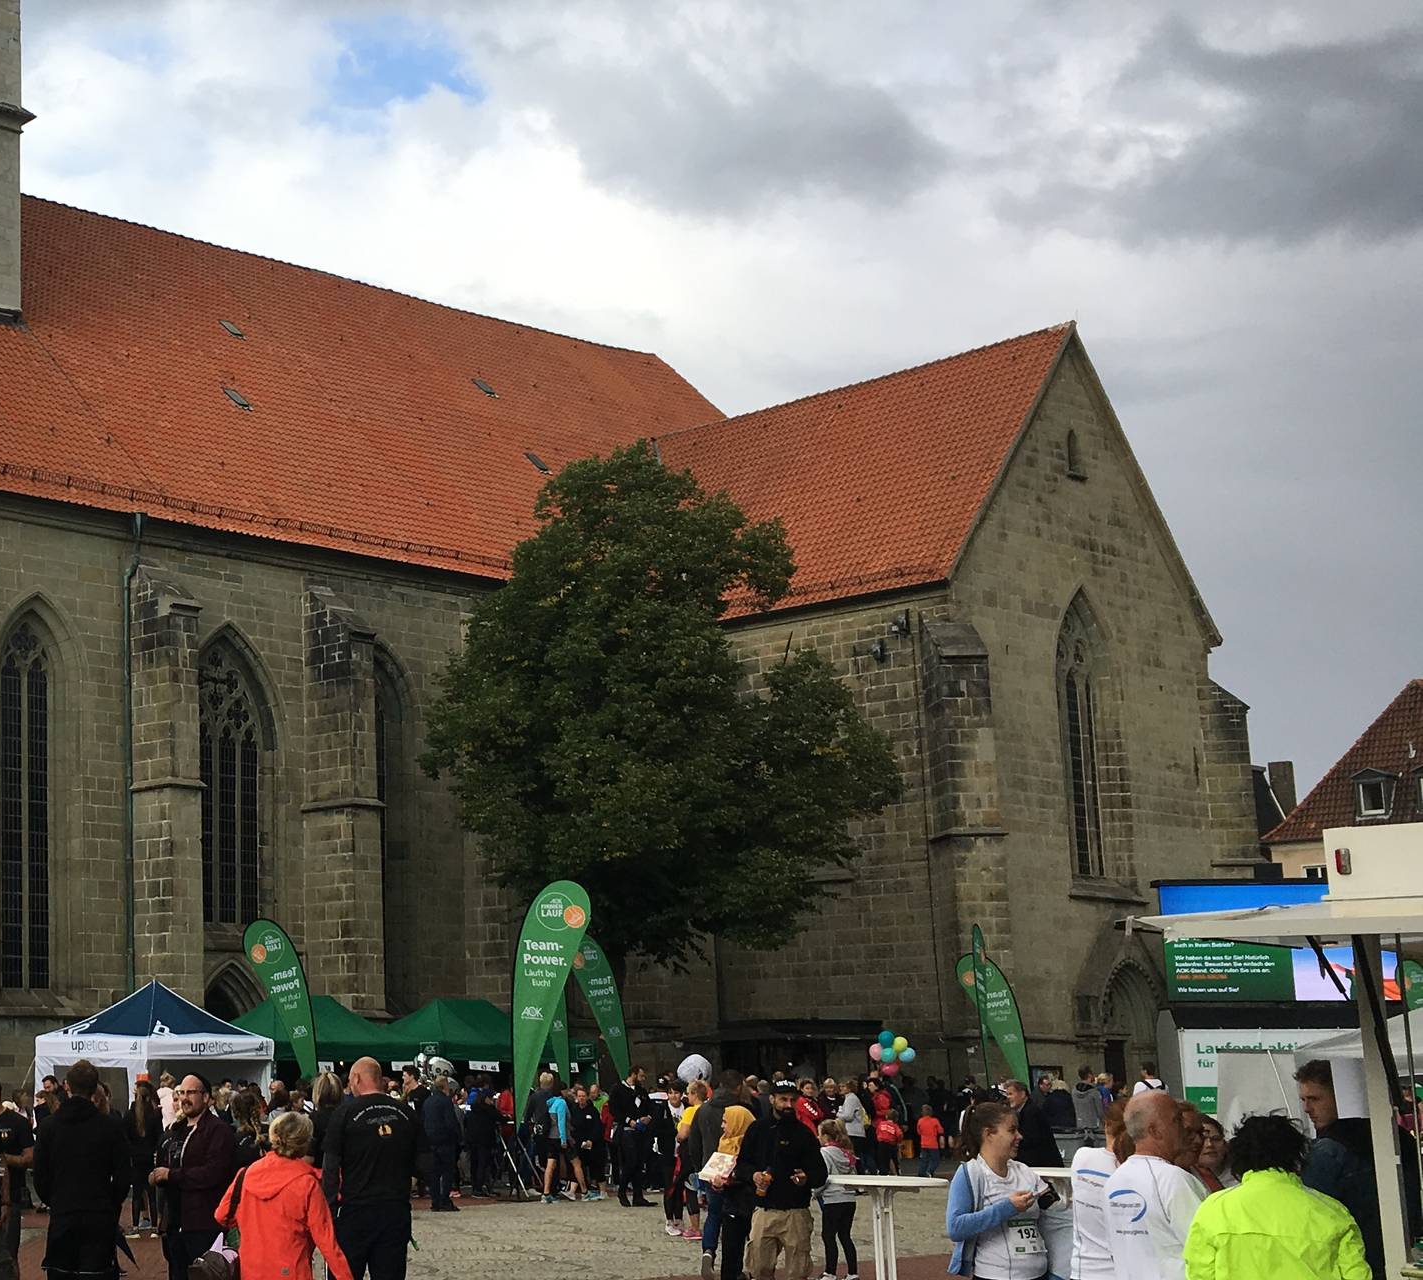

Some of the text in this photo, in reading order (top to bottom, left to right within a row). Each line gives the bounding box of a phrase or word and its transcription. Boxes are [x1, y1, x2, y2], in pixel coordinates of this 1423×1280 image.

[541, 909, 563, 918] LAUF
[523, 939, 564, 952] Team-
[522, 953, 568, 967] Power.
[545, 969, 557, 979] bei
[520, 1006, 544, 1017] AOK
[190, 1039, 234, 1055] upletics
[1198, 1060, 1215, 1068] für
[1017, 1227, 1039, 1239] 192
